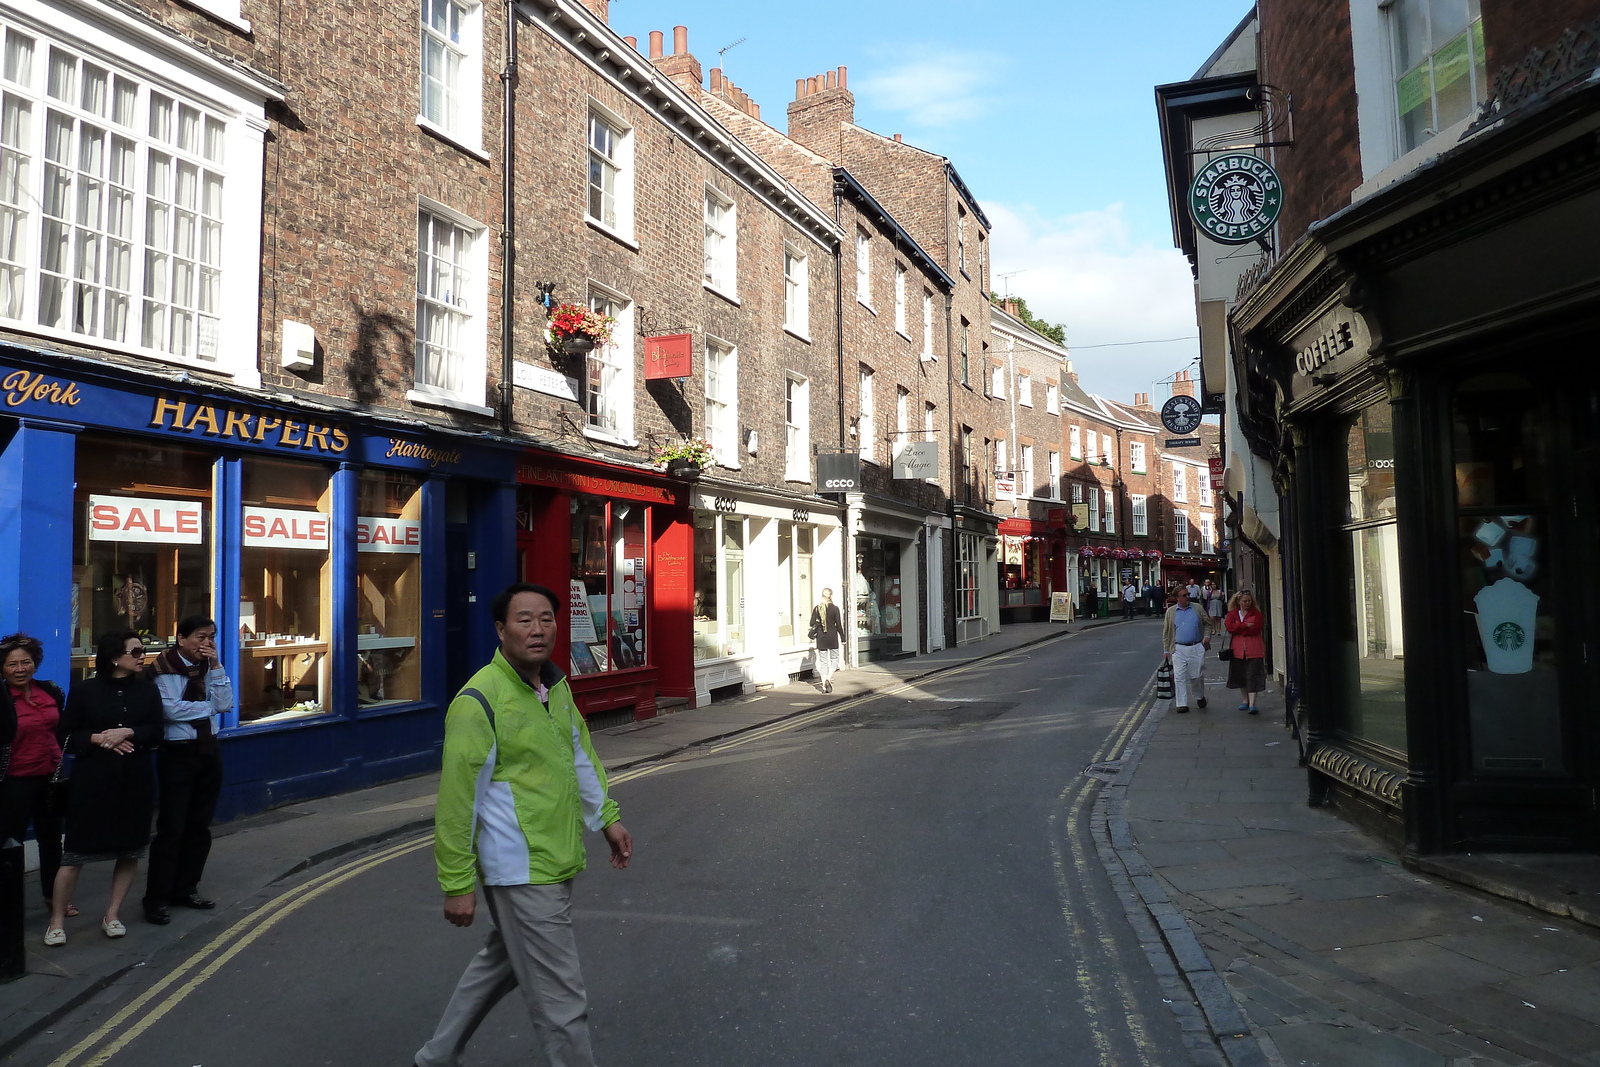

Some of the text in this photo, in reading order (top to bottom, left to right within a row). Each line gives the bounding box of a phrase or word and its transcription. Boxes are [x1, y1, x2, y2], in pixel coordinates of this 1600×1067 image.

[1195, 158, 1277, 198] STARBUCKS
[1205, 212, 1270, 237] COFFEE
[1295, 322, 1354, 377] COFFEE
[2, 369, 81, 406] York
[146, 391, 350, 452] HARPERS
[386, 438, 462, 468] Harrogate
[522, 464, 545, 481] FINE
[545, 469, 565, 483] ART
[566, 472, 599, 490] PRINTS
[603, 479, 646, 497] ORIGINALS
[825, 478, 855, 489] ecco
[92, 504, 199, 534] SALE
[714, 496, 737, 512] ecco
[792, 508, 809, 522] ecco
[245, 514, 327, 541] SALE
[357, 523, 420, 546] SALE
